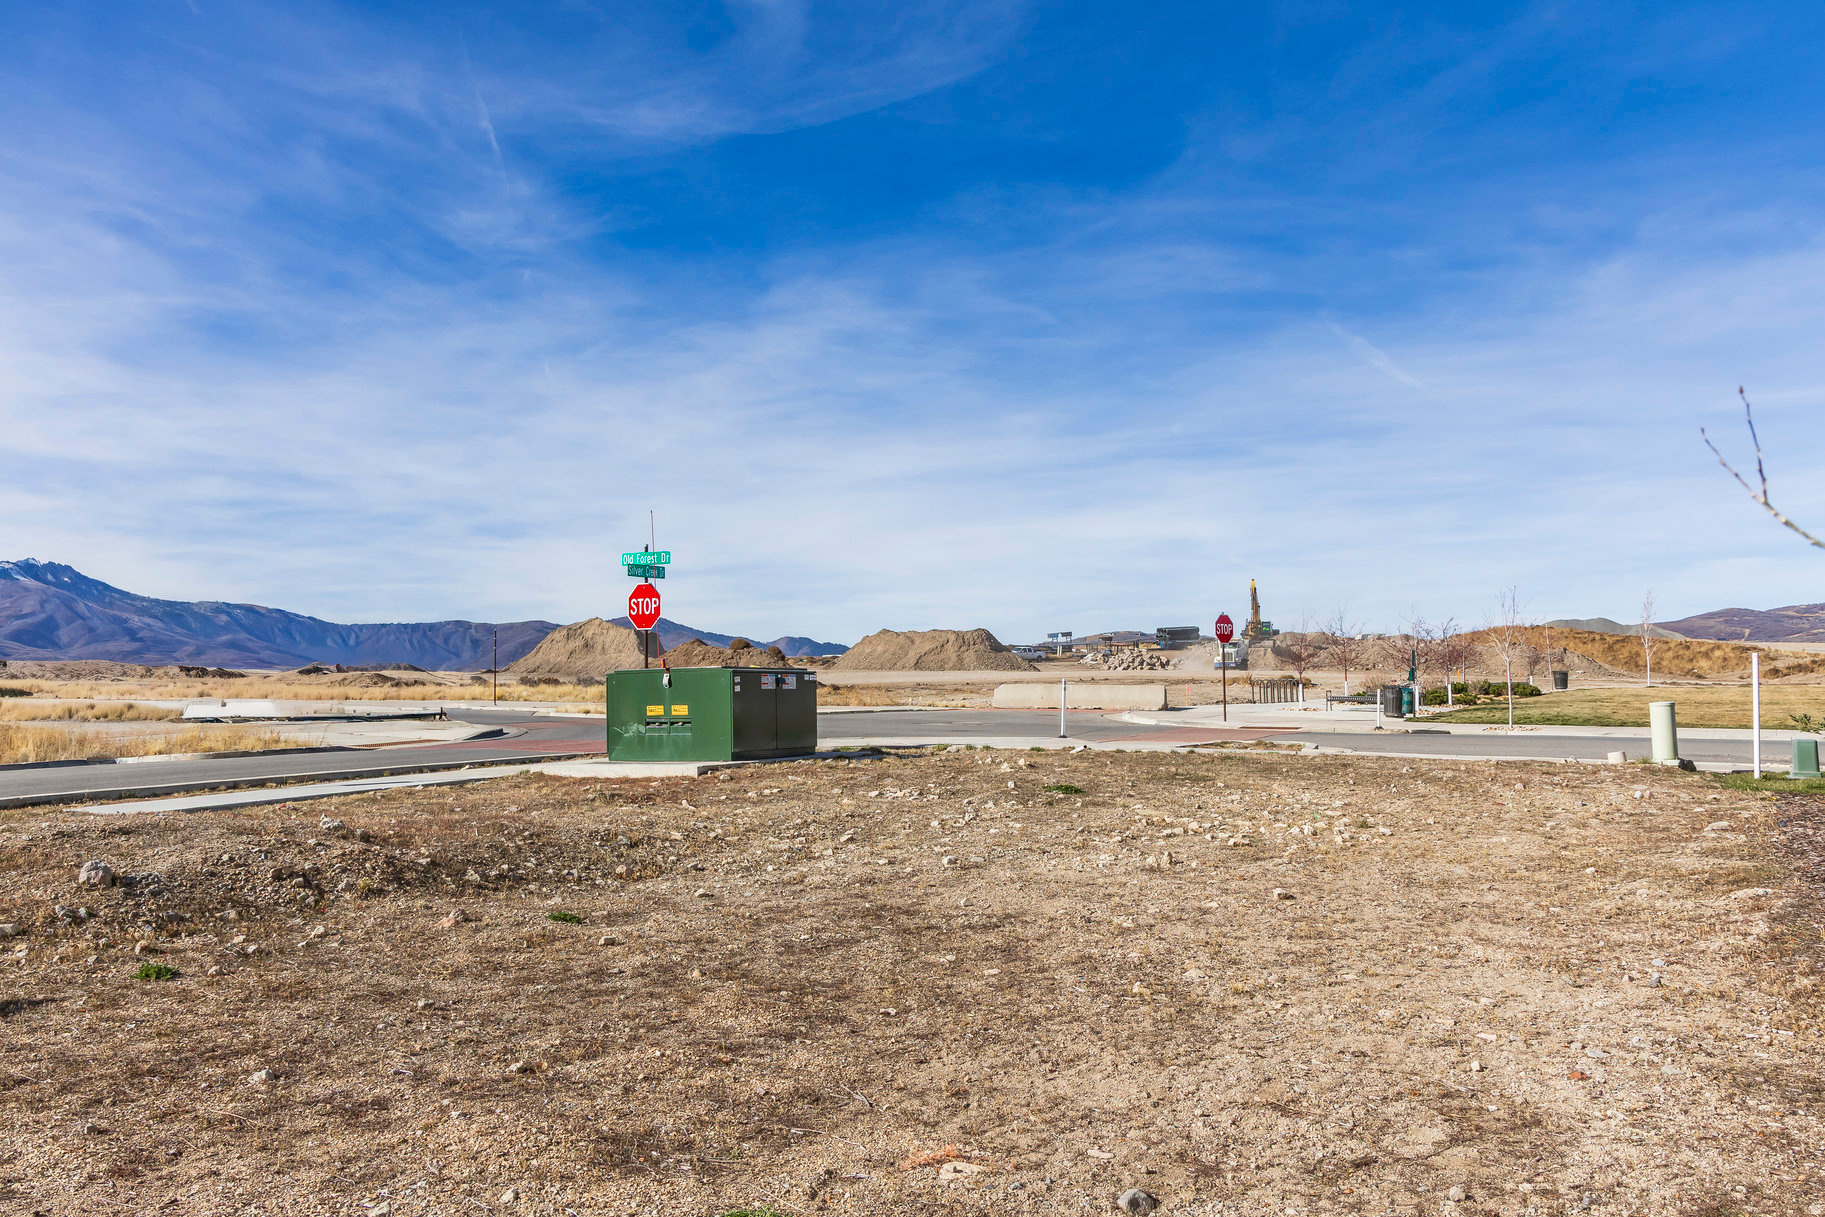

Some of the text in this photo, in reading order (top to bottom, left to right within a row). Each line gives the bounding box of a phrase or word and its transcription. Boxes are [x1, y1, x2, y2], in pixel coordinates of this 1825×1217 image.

[623, 552, 669, 565] Old Forest Dr
[628, 565, 643, 575] Silver
[630, 598, 659, 615] STOP
[1216, 623, 1232, 635] STOP
